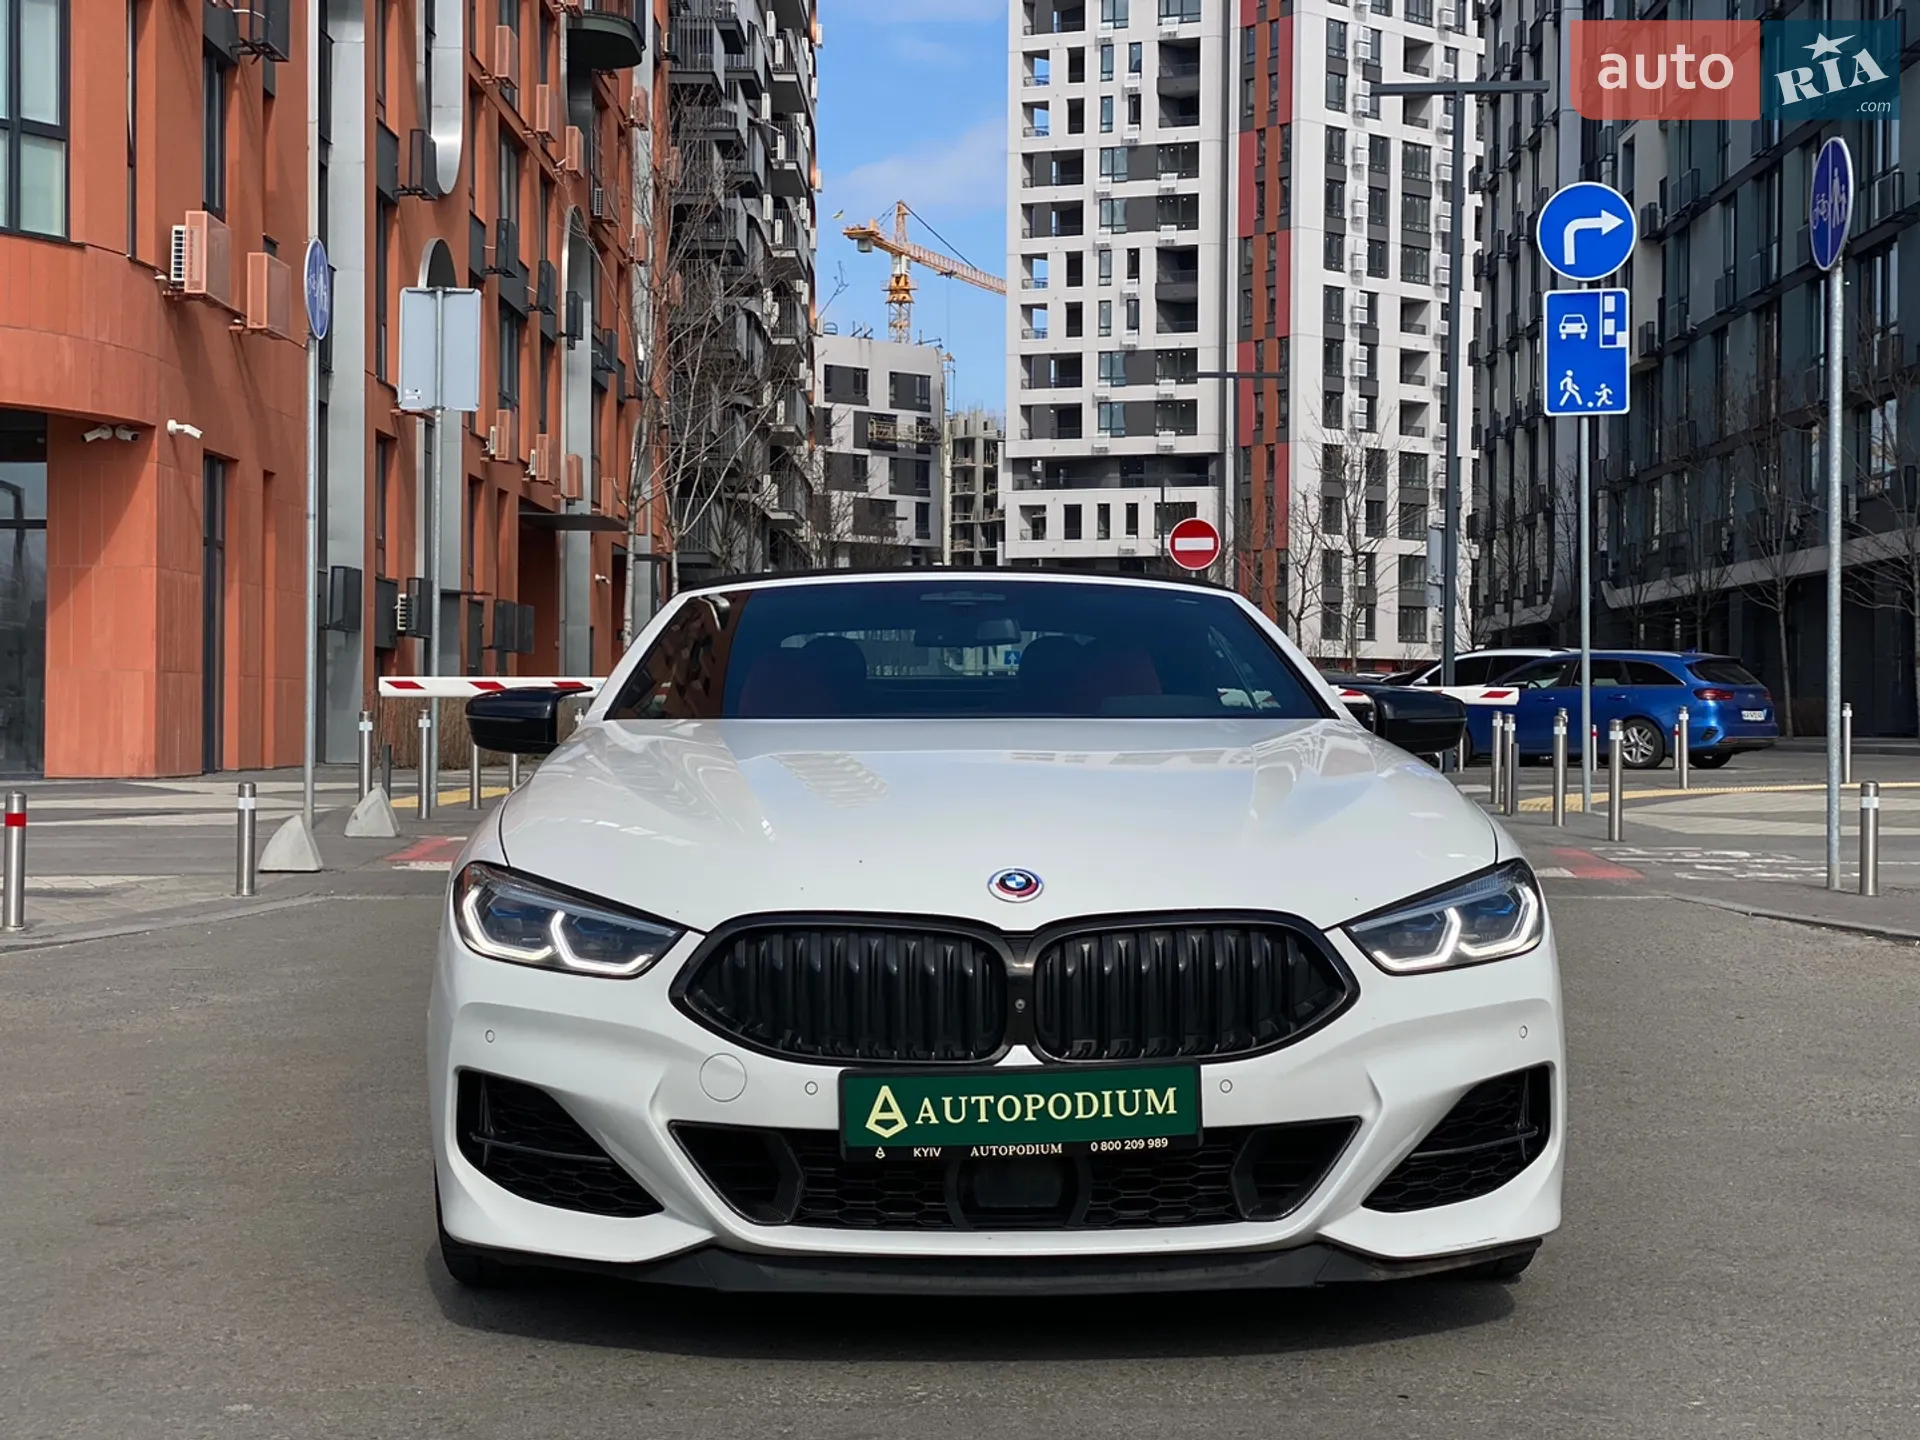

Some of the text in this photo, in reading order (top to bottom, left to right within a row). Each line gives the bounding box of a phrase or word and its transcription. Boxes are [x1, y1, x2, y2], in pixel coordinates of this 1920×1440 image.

[915, 1087, 1178, 1125] AUTOPODIUM
[913, 1137, 1169, 1158] KYIV AUTOPODIUM 0 800 209 989
